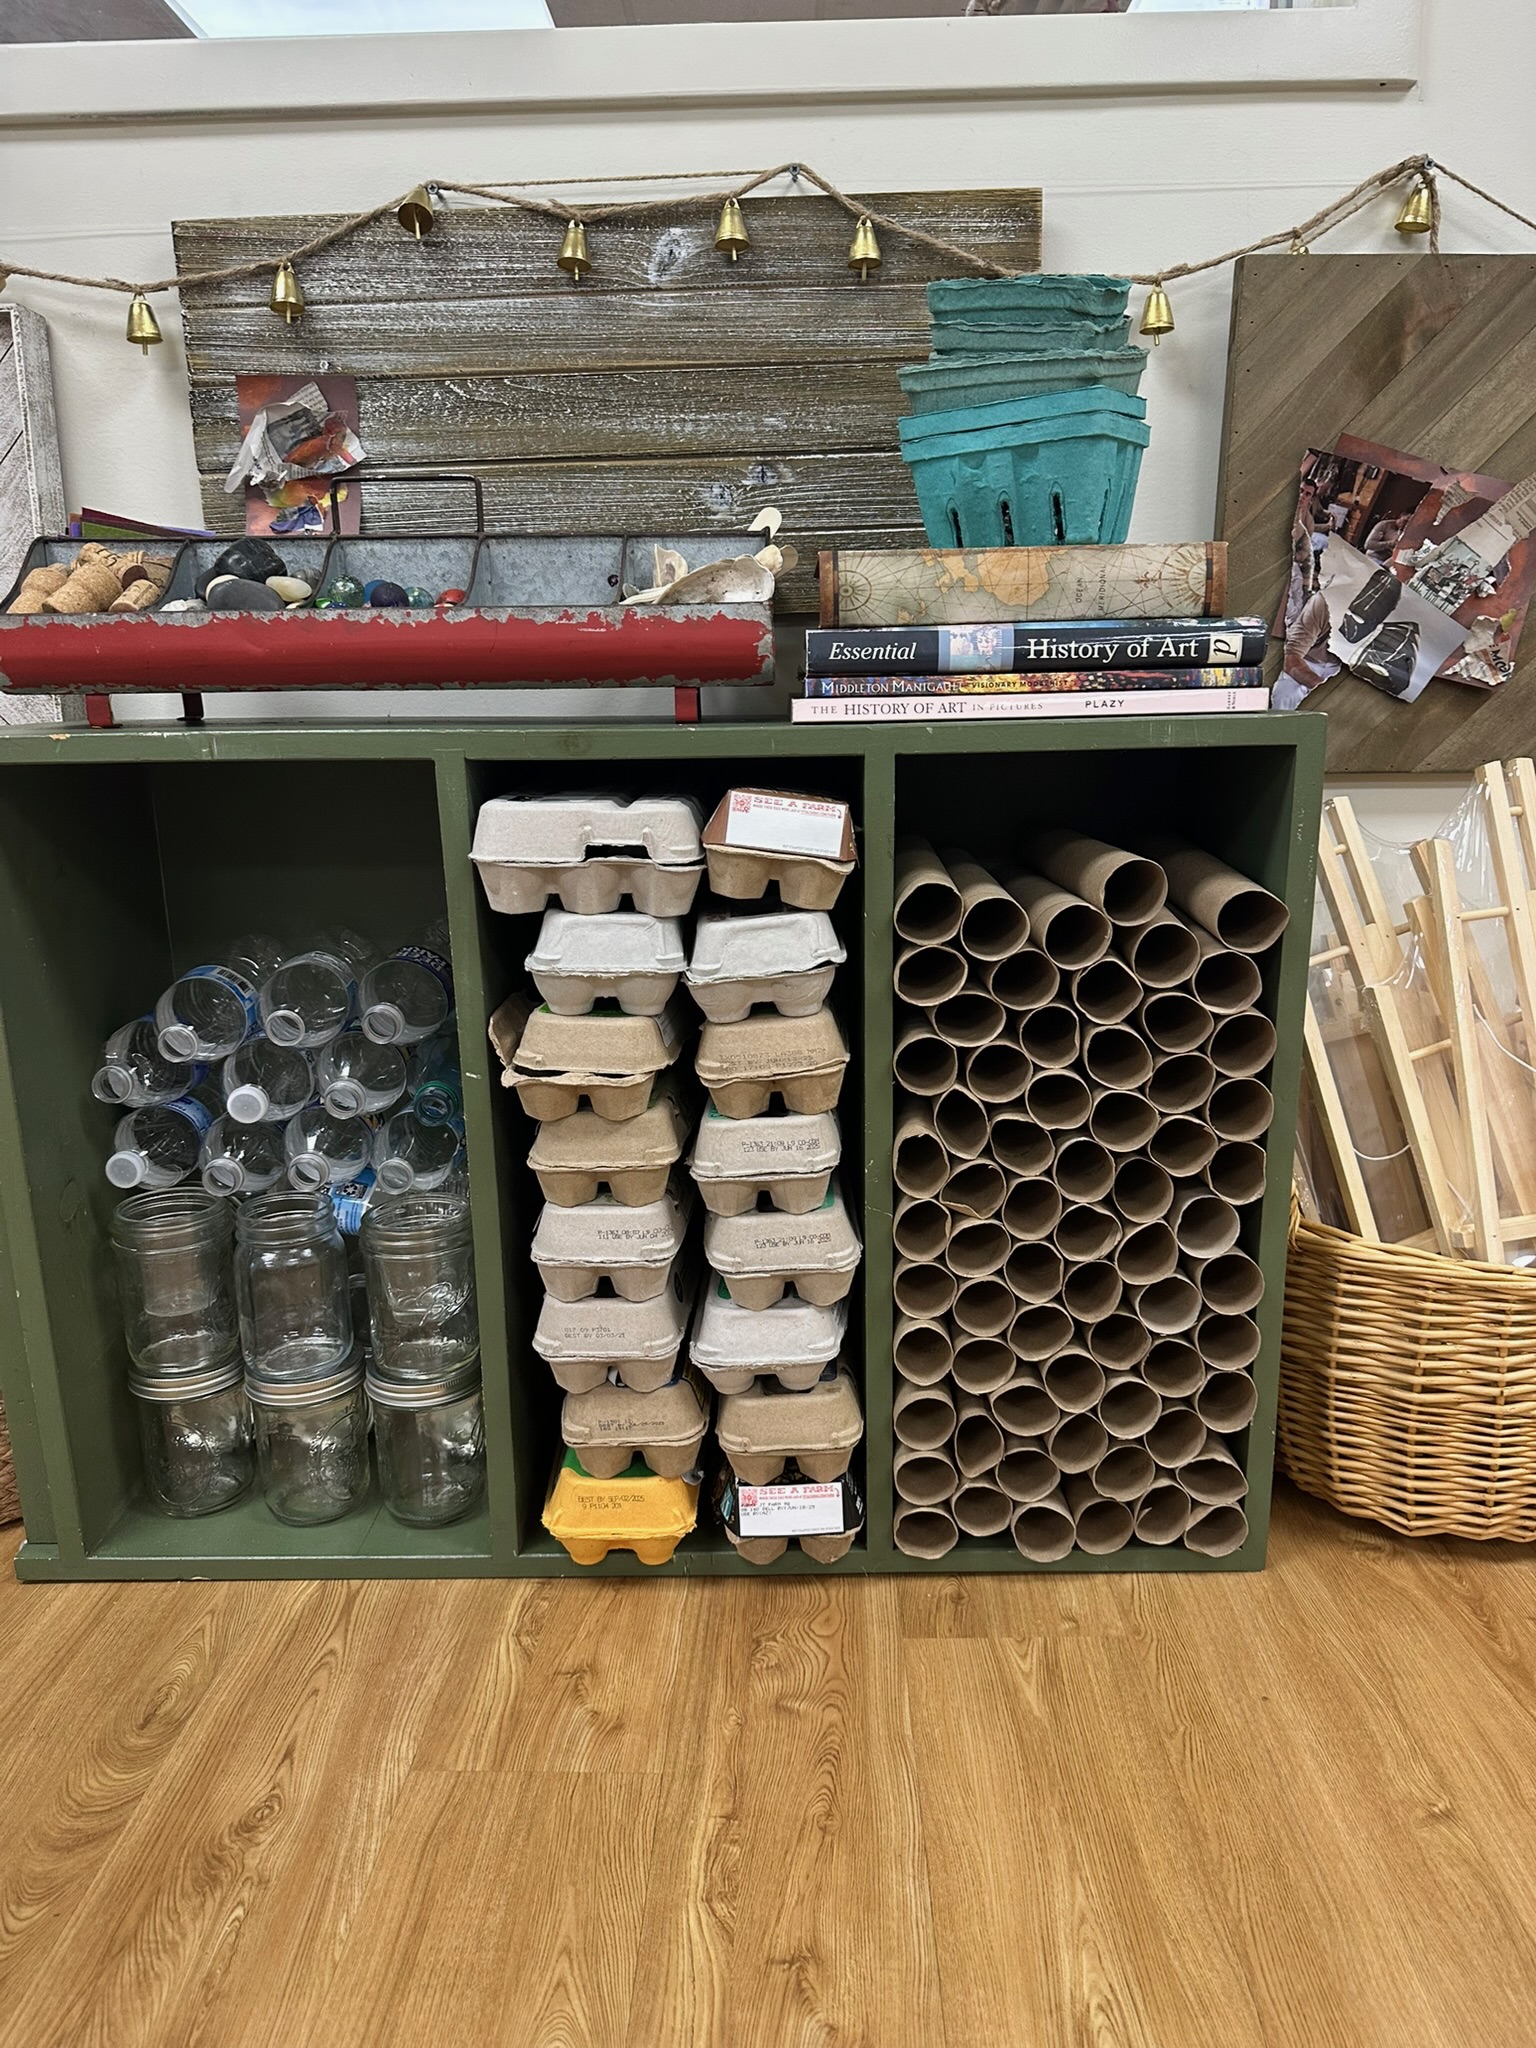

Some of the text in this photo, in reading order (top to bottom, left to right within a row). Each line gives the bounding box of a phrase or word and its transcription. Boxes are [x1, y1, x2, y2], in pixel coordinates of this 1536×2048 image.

[1075, 577, 1083, 603] OCEAN
[828, 637, 1199, 664] Essential History of Art
[971, 681, 1017, 689] VISIONARY
[811, 705, 838, 715] THE
[844, 703, 910, 716] HISTORY
[914, 702, 935, 714] OF
[938, 702, 968, 714] ART
[1085, 700, 1125, 709] PLAZY
[753, 796, 784, 806] SEE
[787, 800, 798, 808] A
[801, 802, 837, 813] FARM
[759, 1487, 786, 1495] SEE
[803, 1485, 834, 1493] FARM
